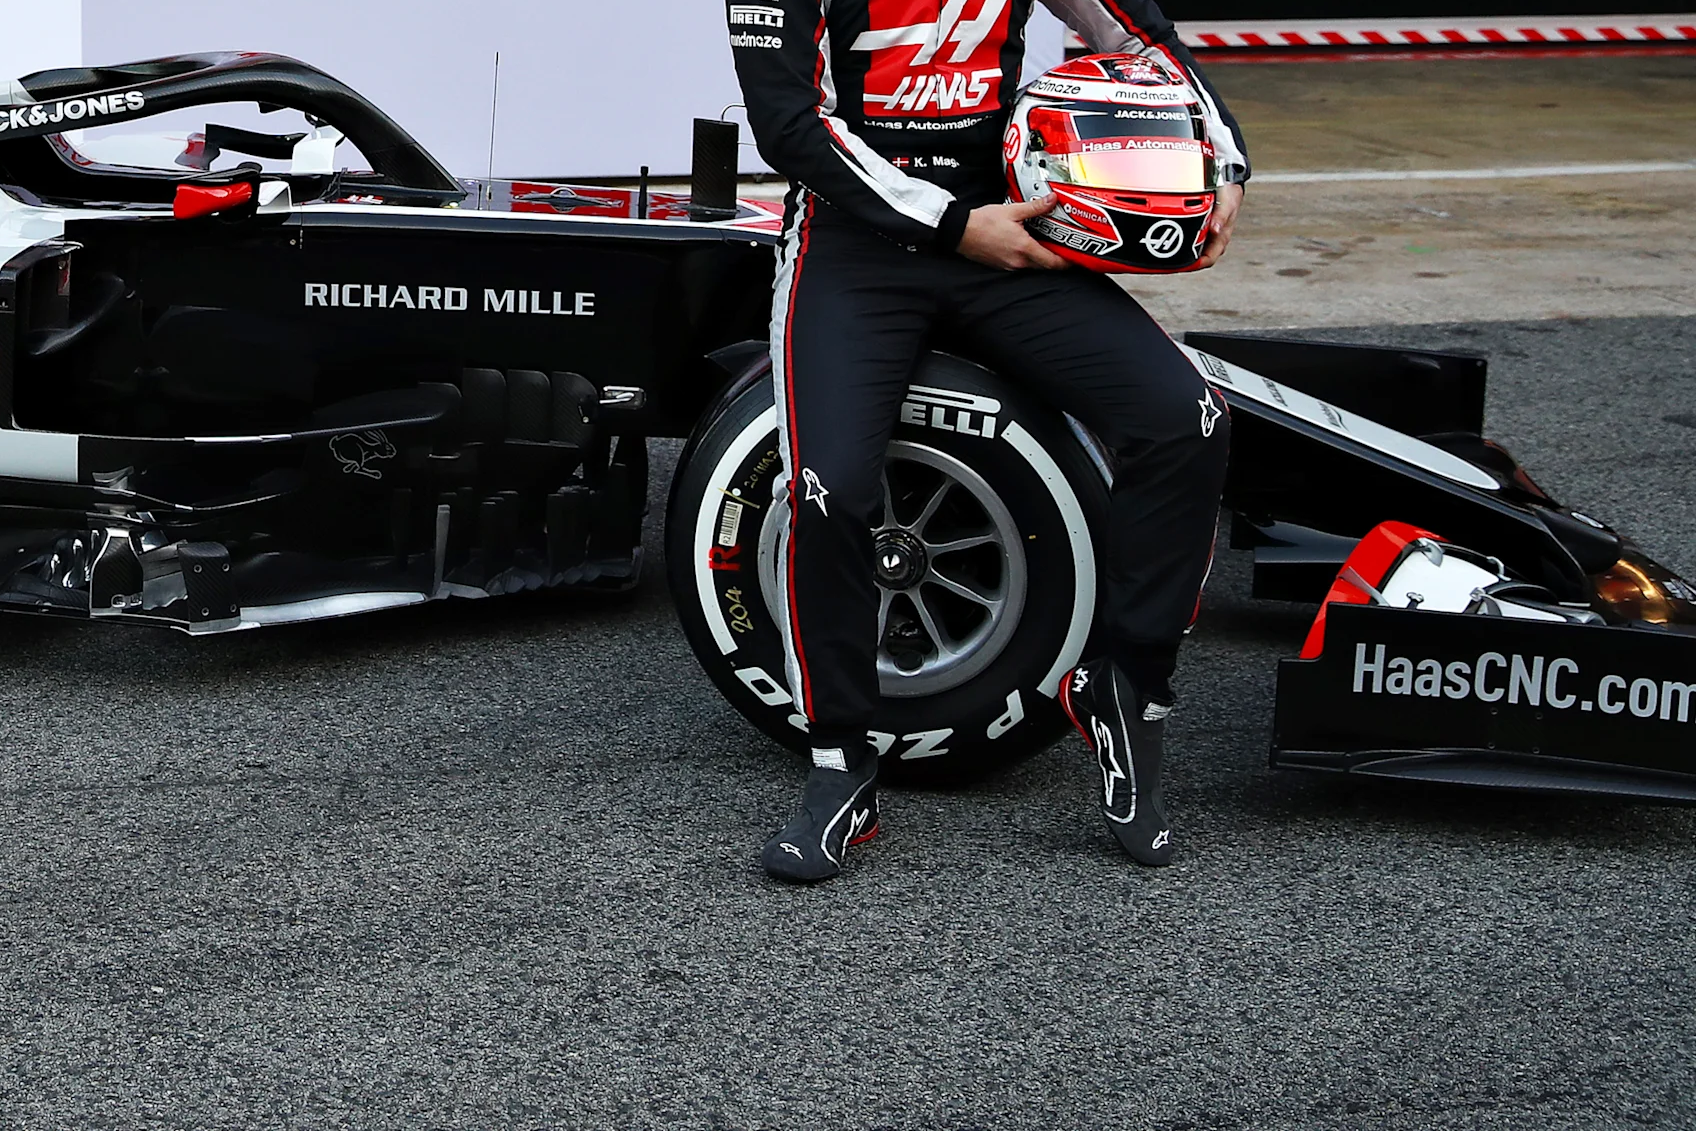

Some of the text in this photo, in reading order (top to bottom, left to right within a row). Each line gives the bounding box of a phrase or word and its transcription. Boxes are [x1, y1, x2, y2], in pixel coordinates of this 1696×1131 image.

[730, 5, 784, 28] PIRELLI
[863, 68, 1003, 111] HAAS
[1115, 90, 1180, 101] mindmaze
[1114, 109, 1187, 121] JACK&JONES
[1082, 140, 1122, 152] Haas
[1126, 140, 1201, 152] Automation
[914, 157, 928, 167] K.
[1071, 206, 1108, 224] OMNICAR
[304, 282, 596, 316] RICHARD MILLE
[1353, 643, 1696, 724] HaasCNC.com
[990, 689, 1024, 739] P
